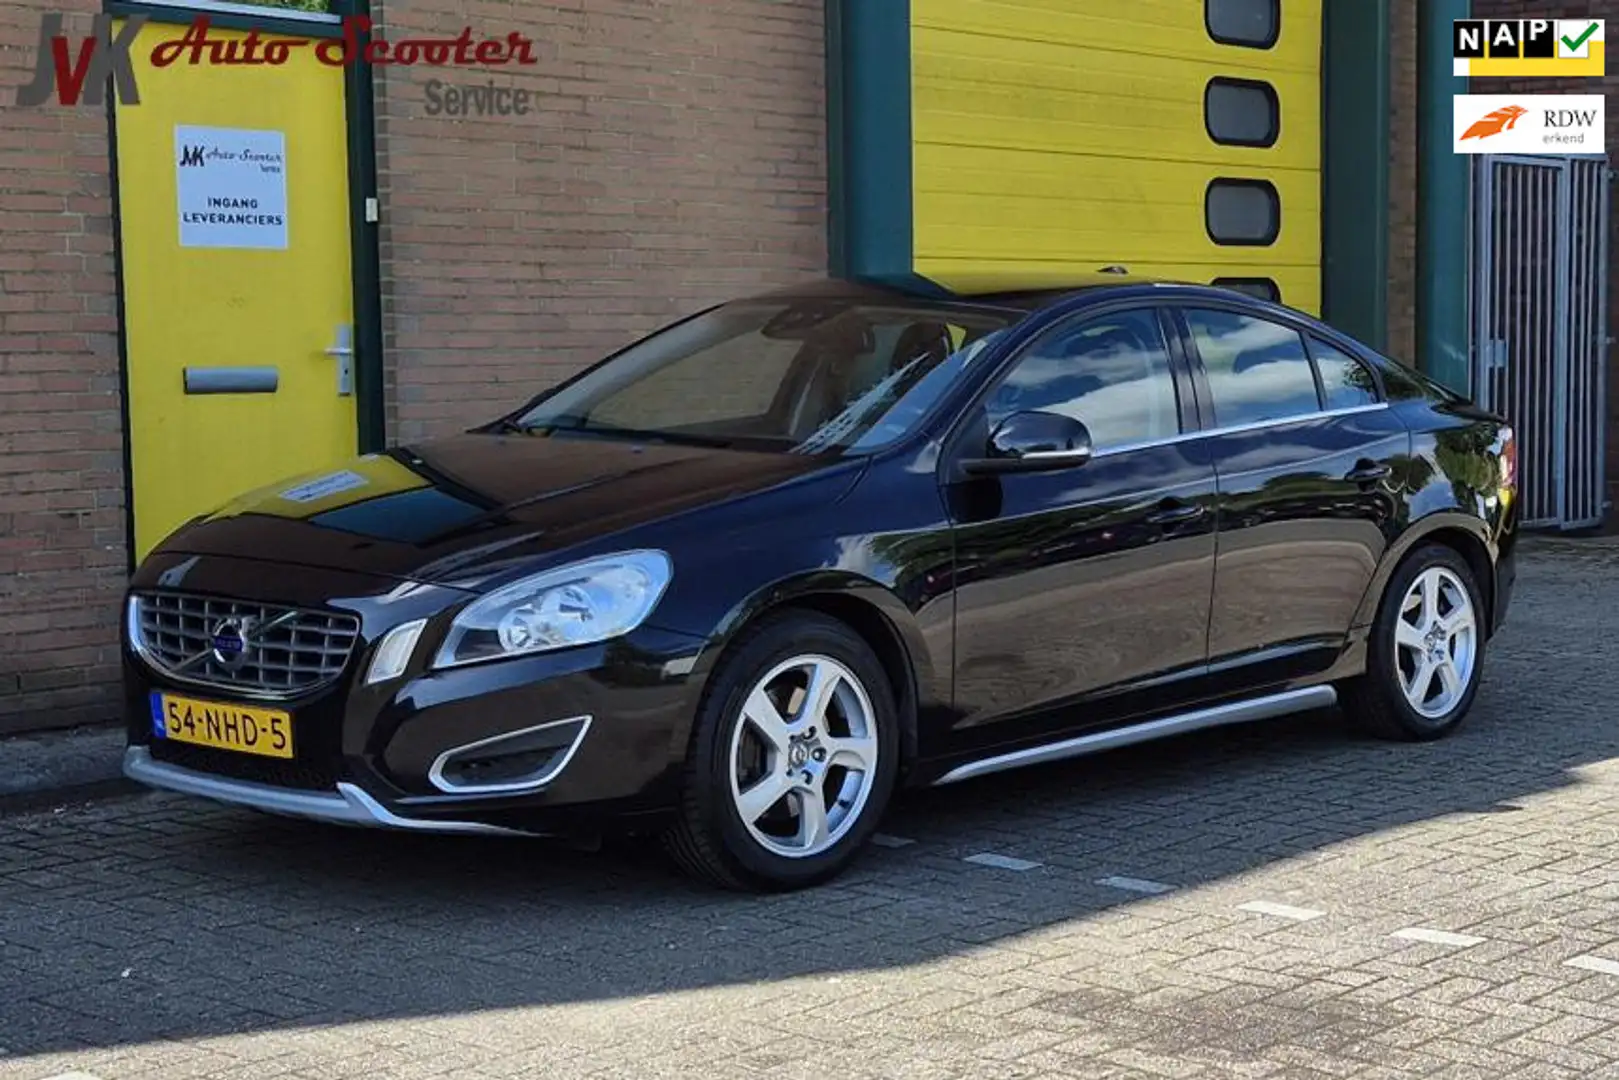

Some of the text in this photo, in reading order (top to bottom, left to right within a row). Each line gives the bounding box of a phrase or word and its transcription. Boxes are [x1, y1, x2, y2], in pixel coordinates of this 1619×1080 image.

[207, 197, 258, 208] INGANG
[183, 212, 282, 225] LEVERANCIERS
[168, 702, 286, 749] 54-NHD-5
